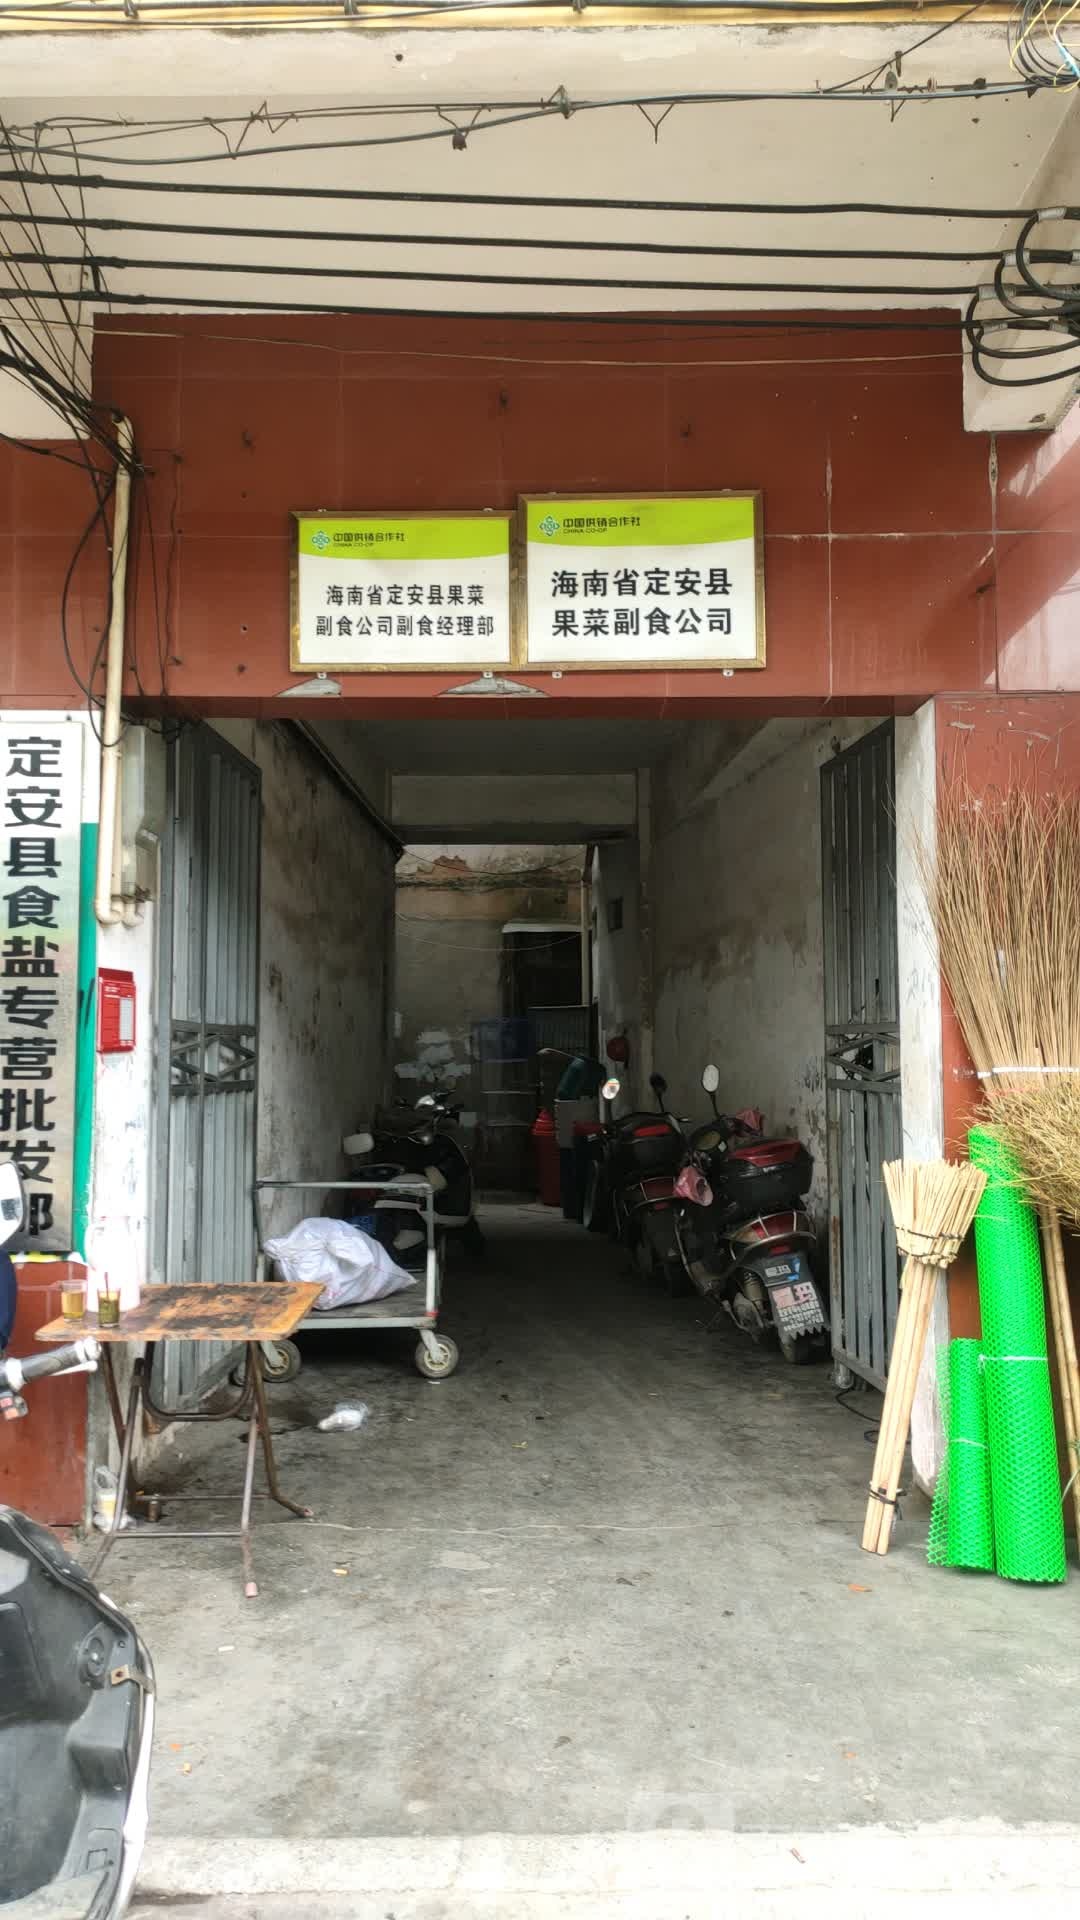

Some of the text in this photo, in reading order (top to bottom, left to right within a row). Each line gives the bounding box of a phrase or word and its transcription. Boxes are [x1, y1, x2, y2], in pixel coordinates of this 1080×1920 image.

[563, 516, 640, 528] 中国供销合作社
[326, 583, 485, 607] 海南省定安县果菜
[551, 568, 733, 599] 海南省定安县
[316, 614, 495, 637] 副食公司副食经理部
[552, 607, 733, 638] 果菜副食公司
